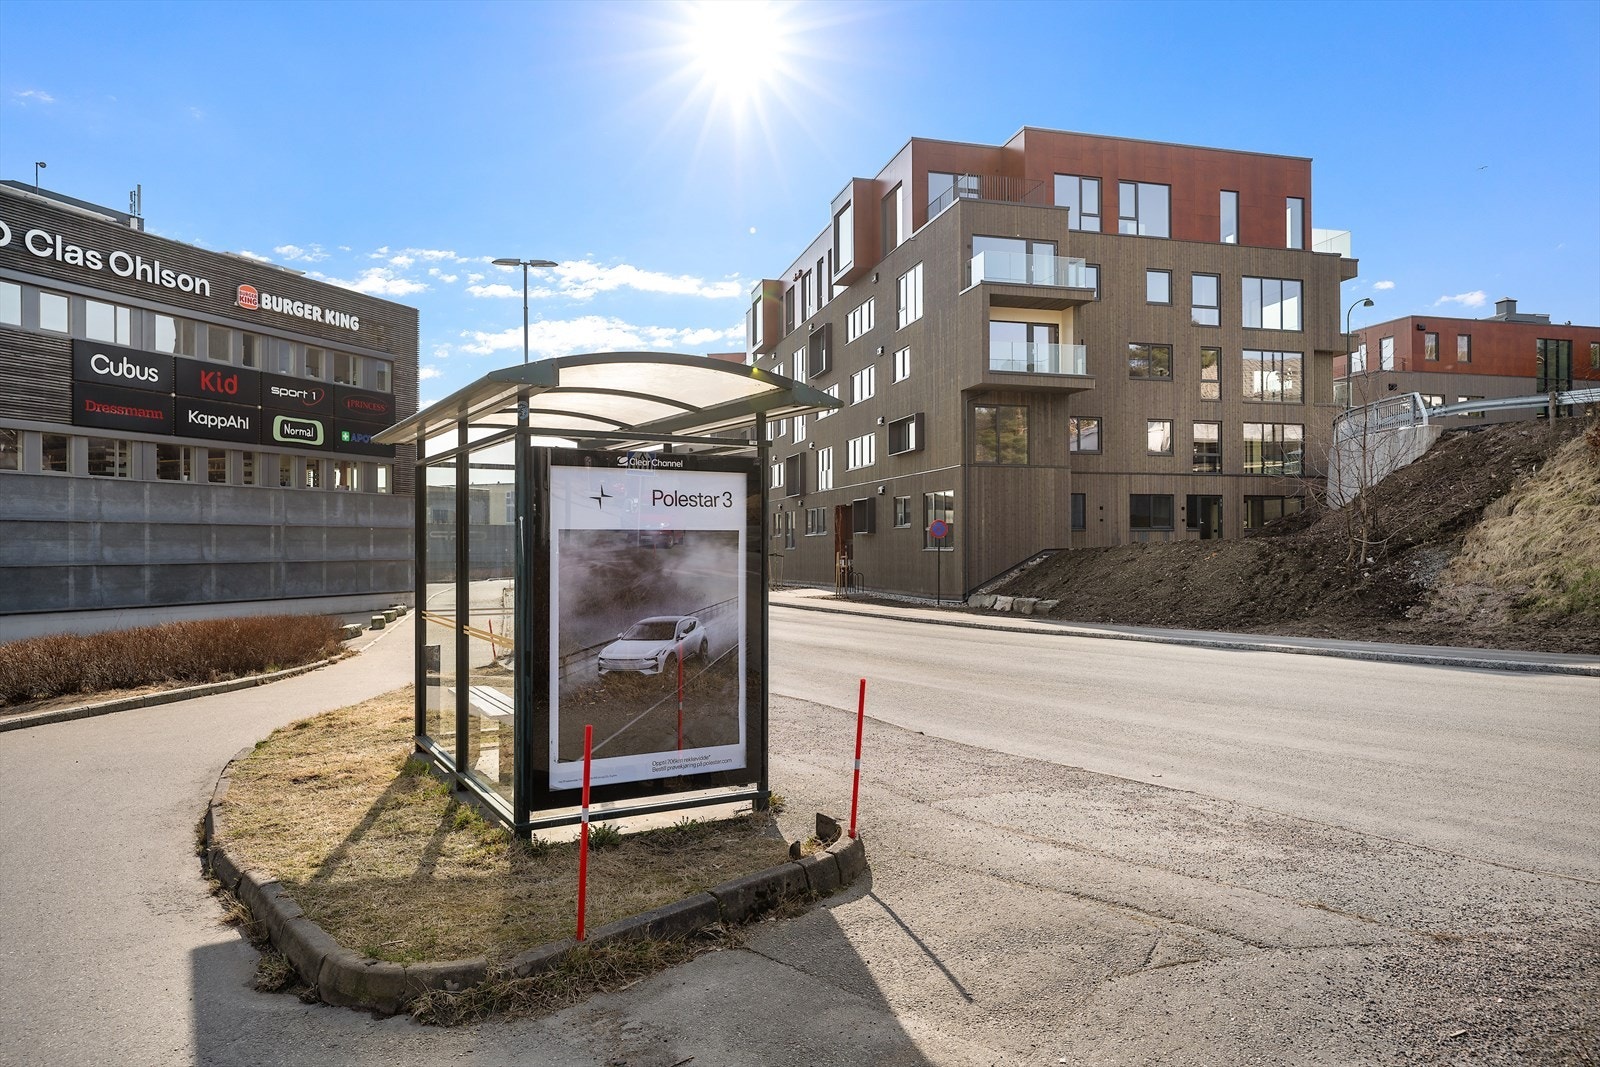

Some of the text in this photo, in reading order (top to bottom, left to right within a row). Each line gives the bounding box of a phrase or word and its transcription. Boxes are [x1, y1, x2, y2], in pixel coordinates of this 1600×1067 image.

[25, 229, 211, 297] Clas Ohlson
[239, 295, 257, 305] KING
[261, 293, 360, 331] BURGER KING
[90, 353, 159, 383] Cubus
[200, 370, 238, 395] Kid
[271, 386, 308, 399] sport
[85, 399, 164, 420] Dressmann
[348, 400, 385, 411] PRINCESS
[188, 409, 249, 430] KappAhl
[284, 423, 314, 437] Normal
[351, 433, 371, 443] APO
[629, 458, 683, 468] Clear Channel
[652, 489, 733, 508] Polestar 3
